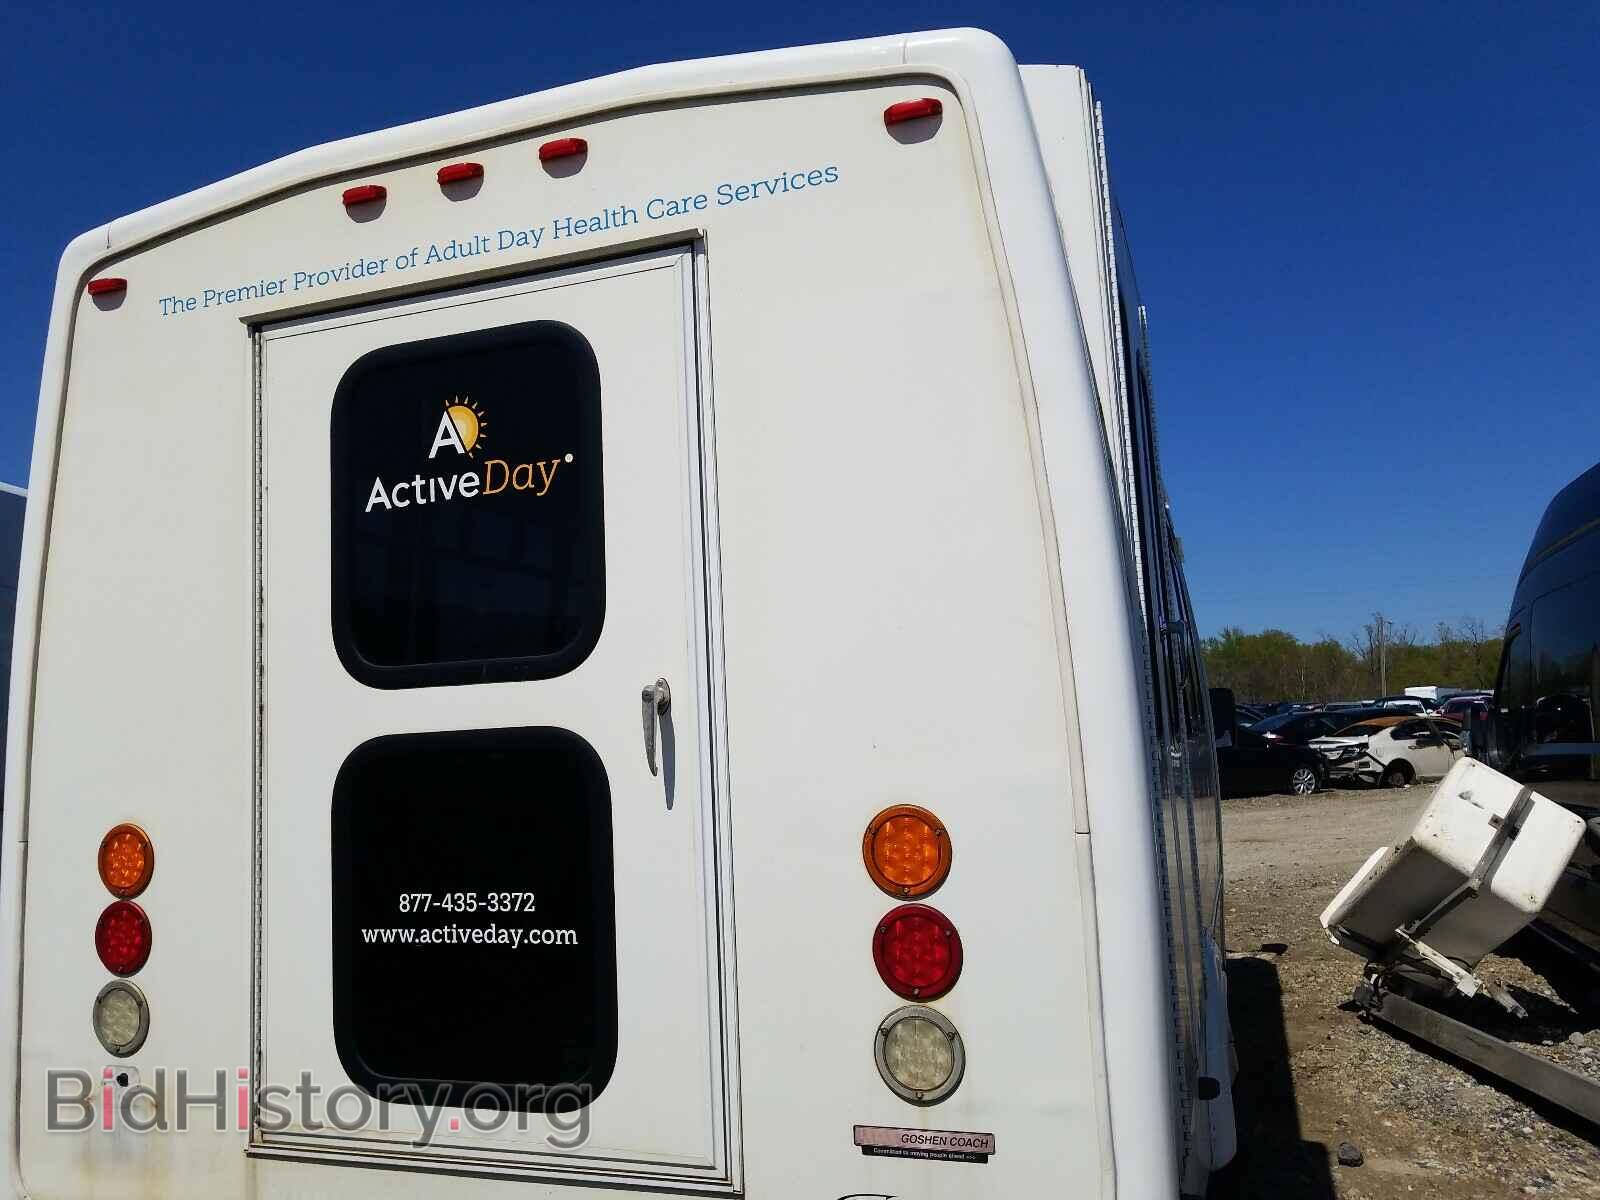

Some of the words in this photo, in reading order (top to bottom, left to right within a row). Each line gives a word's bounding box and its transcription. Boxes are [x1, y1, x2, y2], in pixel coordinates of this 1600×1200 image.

[159, 294, 197, 316] The
[202, 278, 287, 307] Premier
[293, 256, 389, 290] Provider
[395, 248, 420, 270] of
[424, 235, 490, 265] Adult
[497, 227, 544, 252] Day
[552, 205, 639, 240] Health
[646, 193, 708, 220] Care
[716, 165, 839, 206] Services
[398, 892, 536, 913] 877-435-3372
[361, 923, 578, 949] www.activeday.com
[901, 1133, 948, 1146] GOSHEN
[949, 1136, 989, 1149] COACH
